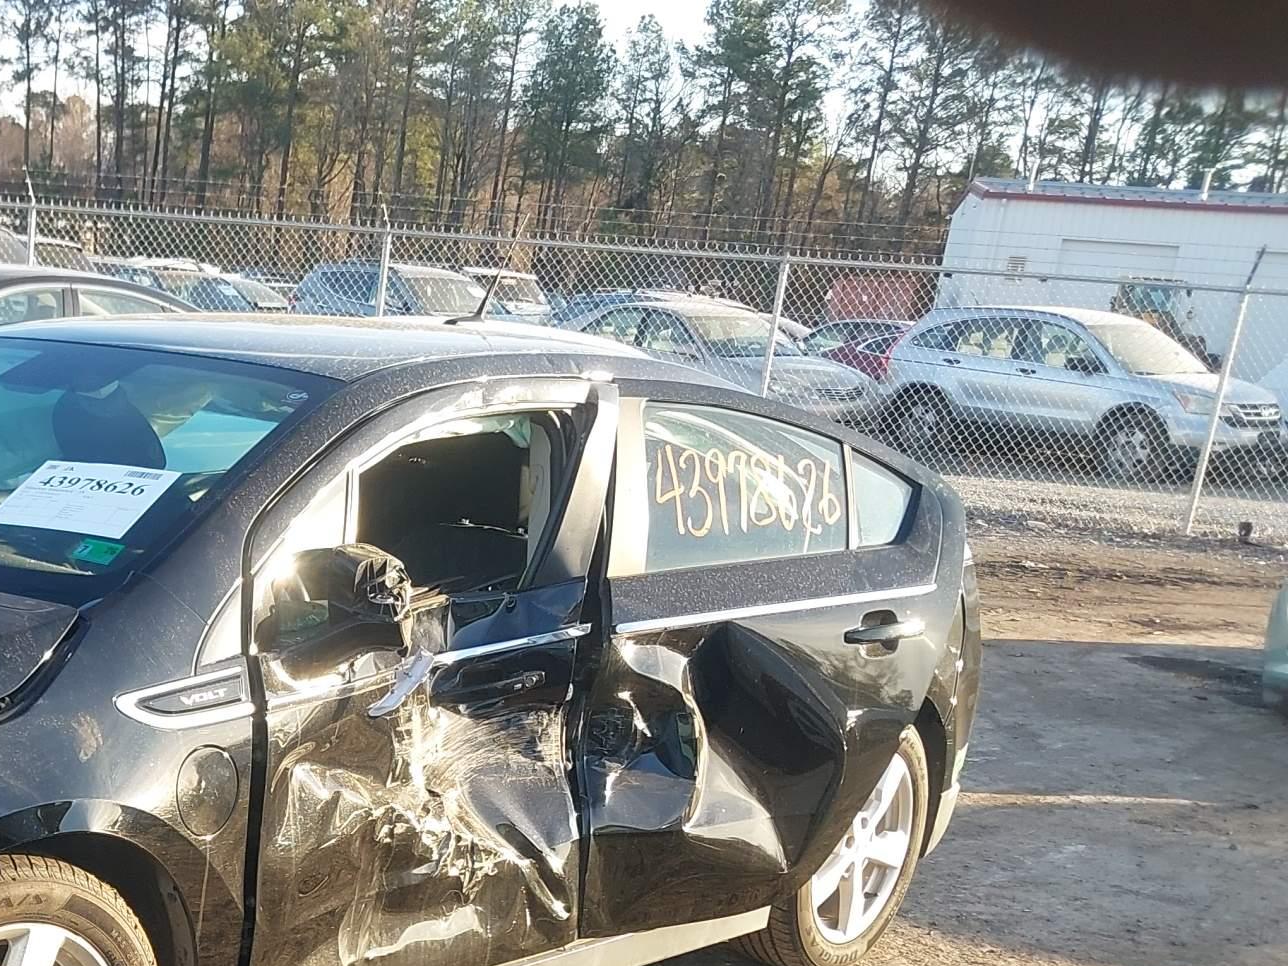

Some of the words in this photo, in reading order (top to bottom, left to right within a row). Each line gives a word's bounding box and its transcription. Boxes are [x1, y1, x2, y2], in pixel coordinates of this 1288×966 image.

[39, 475, 153, 497] 43978626
[655, 444, 842, 537] 43978626
[179, 688, 228, 706] VOLT
